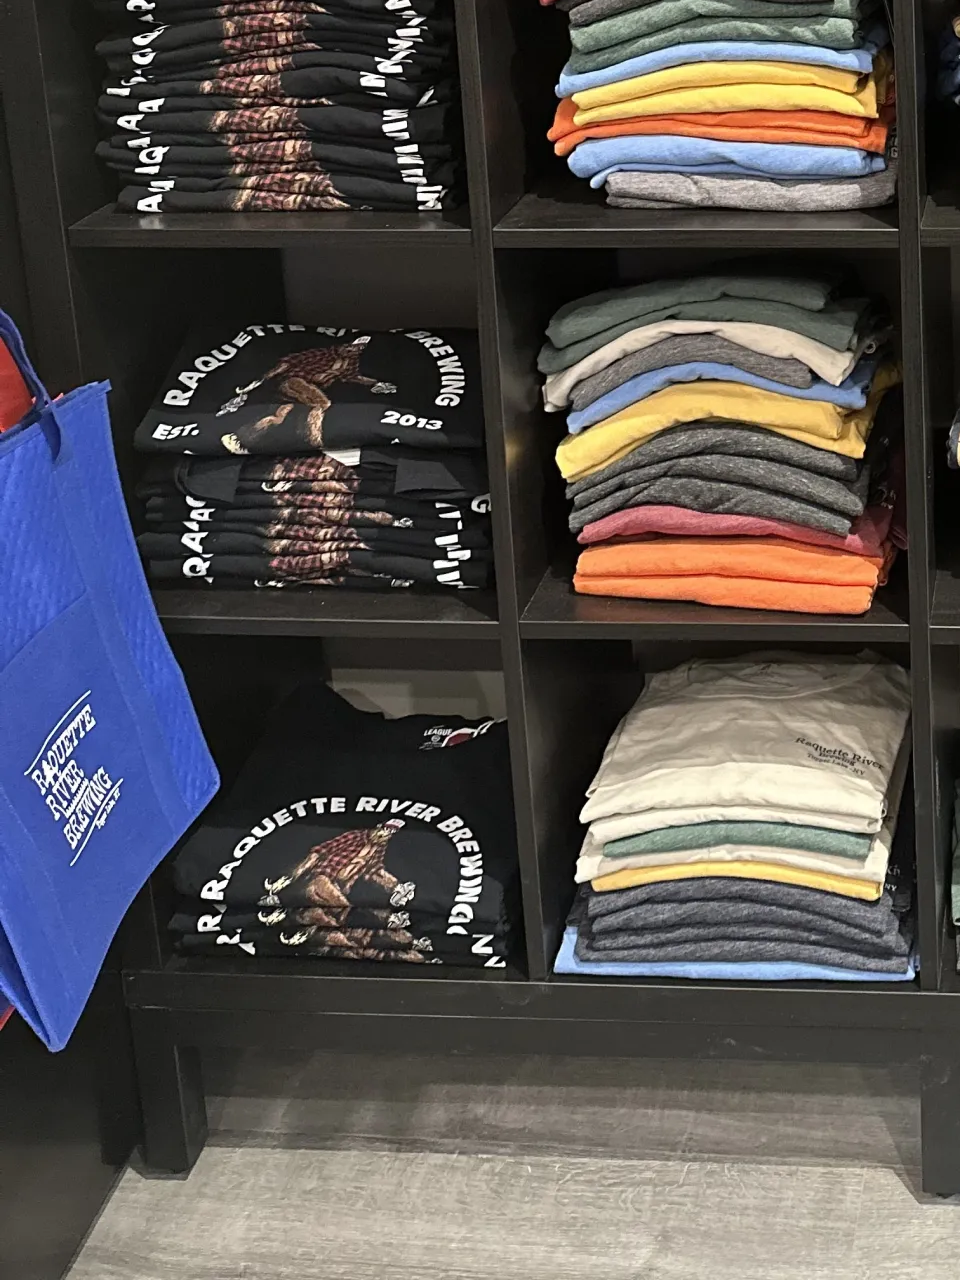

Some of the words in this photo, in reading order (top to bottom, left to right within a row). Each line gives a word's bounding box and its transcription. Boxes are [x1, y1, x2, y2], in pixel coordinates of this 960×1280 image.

[404, 330, 466, 408] BREWING
[152, 422, 199, 440] EST.
[380, 410, 443, 431] 2013
[31, 703, 96, 796] RAQUETTE
[795, 737, 849, 758] Raquette
[852, 753, 885, 770] River
[45, 759, 84, 821] RIVER
[63, 765, 112, 850] BREWING
[201, 796, 346, 901] RAQUETTE
[355, 795, 442, 823] RIVER
